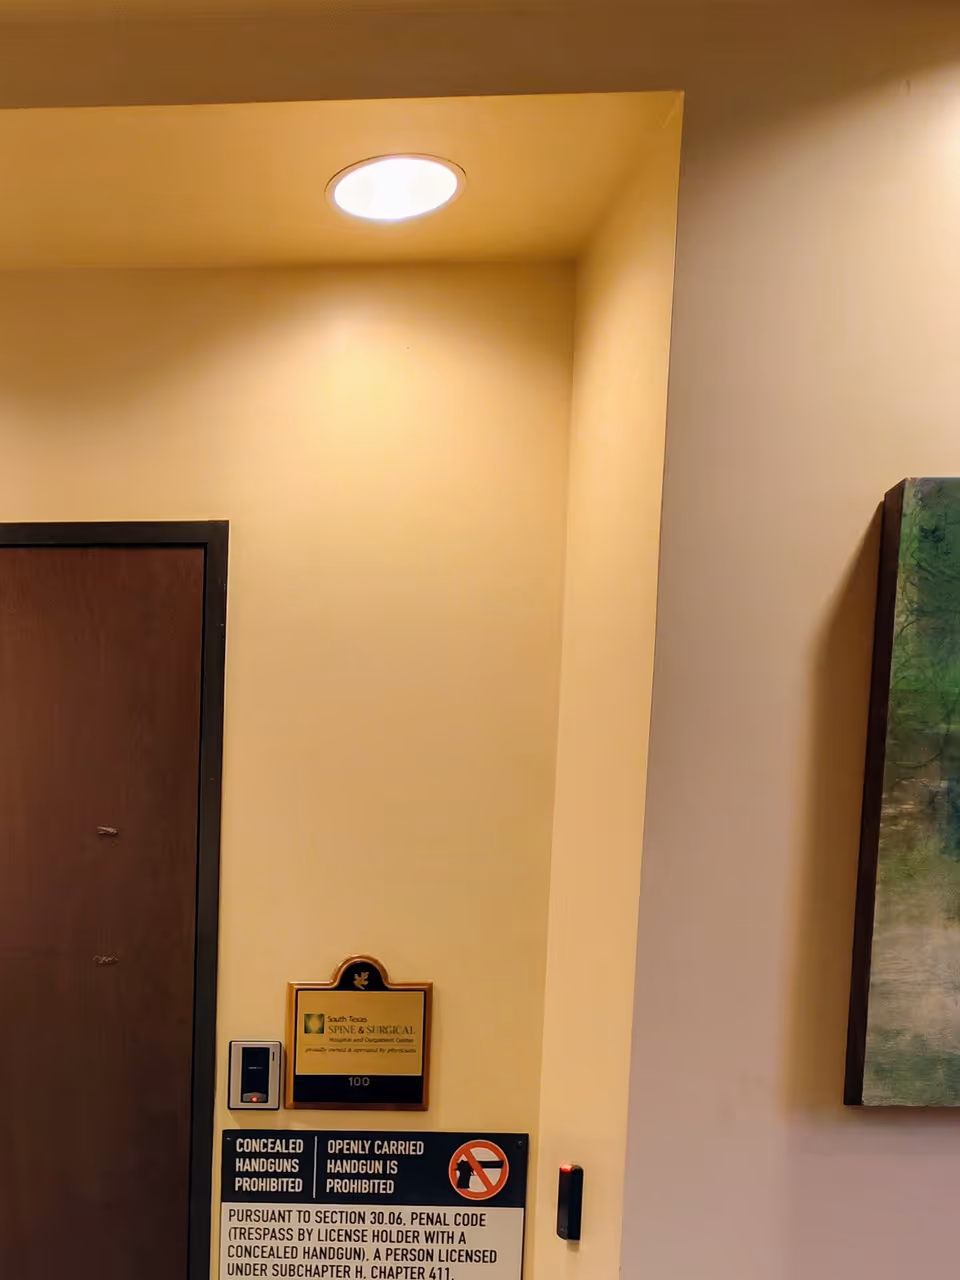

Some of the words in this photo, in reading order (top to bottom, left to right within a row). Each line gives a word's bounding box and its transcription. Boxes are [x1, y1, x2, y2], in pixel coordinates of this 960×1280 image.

[328, 1025, 356, 1034] SPINE
[358, 1026, 364, 1034] &
[366, 1025, 415, 1035] SURGICAL
[348, 1077, 370, 1087] 100
[236, 1138, 304, 1154] CONCEALED
[328, 1140, 370, 1155] OPENLY
[374, 1141, 424, 1156] CARRIED
[235, 1158, 299, 1173] HANDGUNS
[327, 1160, 383, 1175] HANDGUN
[386, 1161, 398, 1175] IS
[235, 1177, 303, 1193] PROHIBITED
[326, 1179, 394, 1194] PROHIBITED
[229, 1209, 293, 1223] PURSUANT
[296, 1210, 311, 1223] TO
[315, 1210, 366, 1224] SECTION
[411, 1212, 450, 1226] PENAL
[454, 1213, 486, 1227] CODE
[228, 1227, 294, 1241] (TRESPASS
[298, 1228, 314, 1241] BY
[318, 1229, 368, 1243] LICENSE
[372, 1230, 420, 1244] HOLDER
[424, 1231, 454, 1244] WITH
[458, 1231, 466, 1245] A
[228, 1245, 298, 1259] CONCEALED
[373, 1248, 381, 1261] A
[386, 1248, 434, 1262] PERSON
[438, 1249, 497, 1264] LICENSED
